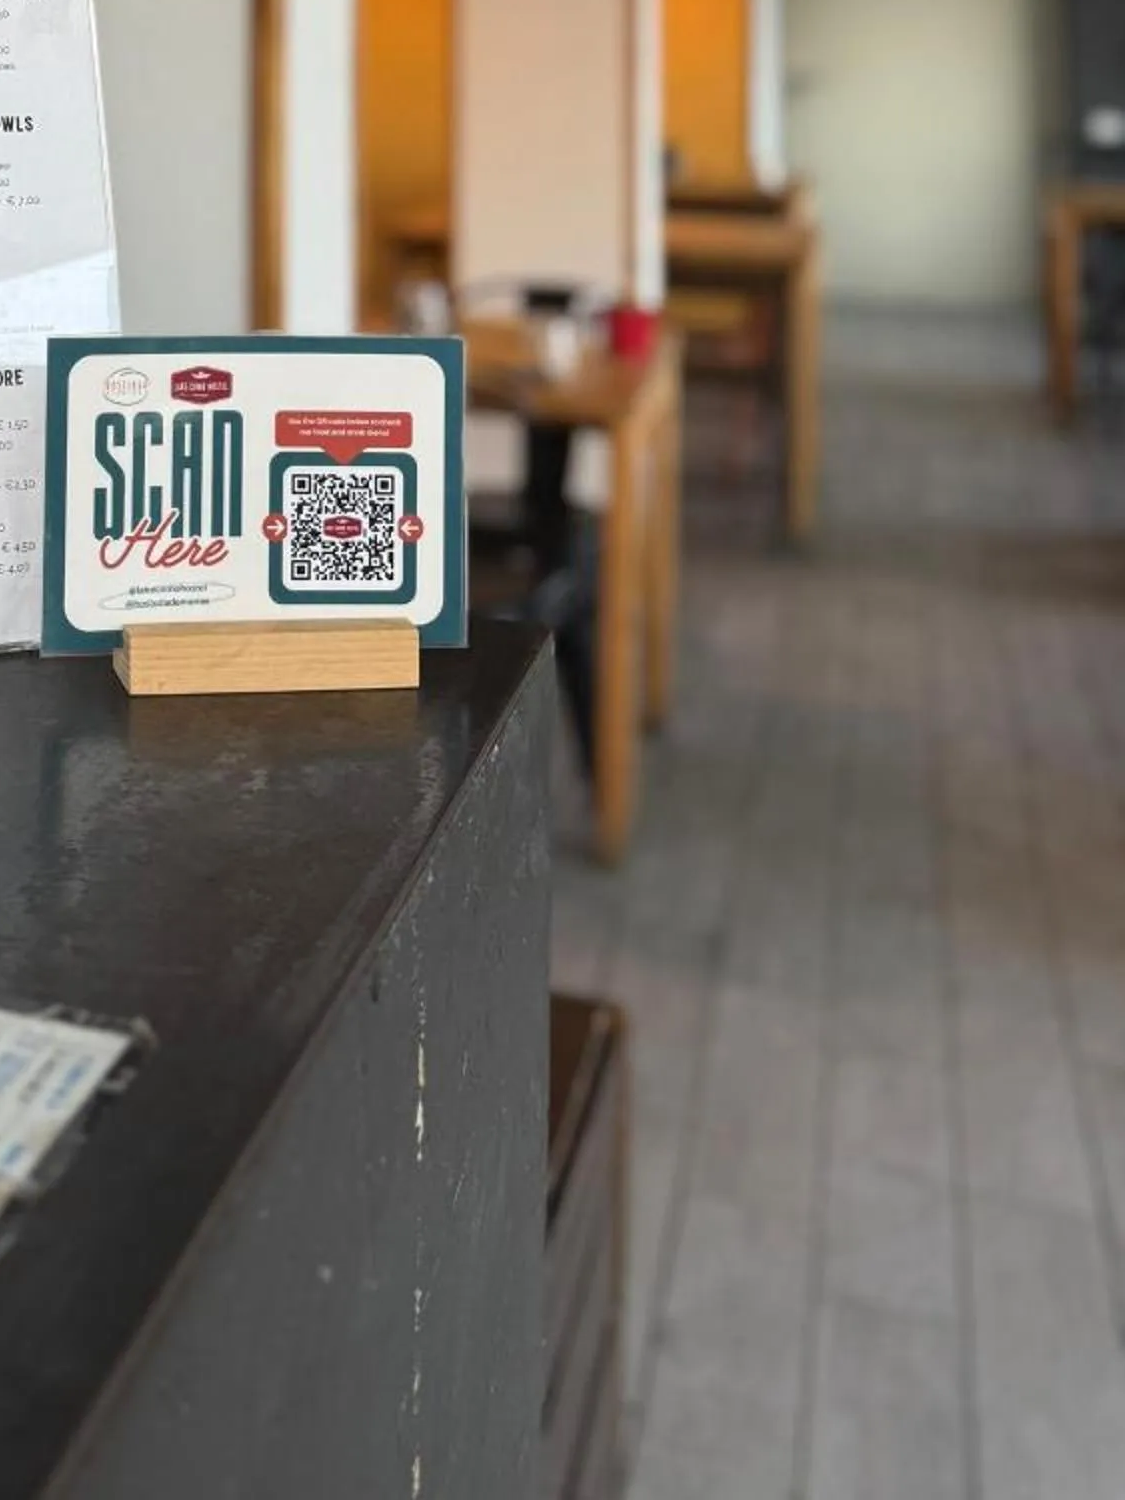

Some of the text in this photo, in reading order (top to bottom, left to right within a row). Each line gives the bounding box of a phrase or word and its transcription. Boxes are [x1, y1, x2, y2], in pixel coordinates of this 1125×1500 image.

[93, 409, 244, 540] SCAN
[1, 543, 11, 554] €
[99, 510, 229, 569] Here
